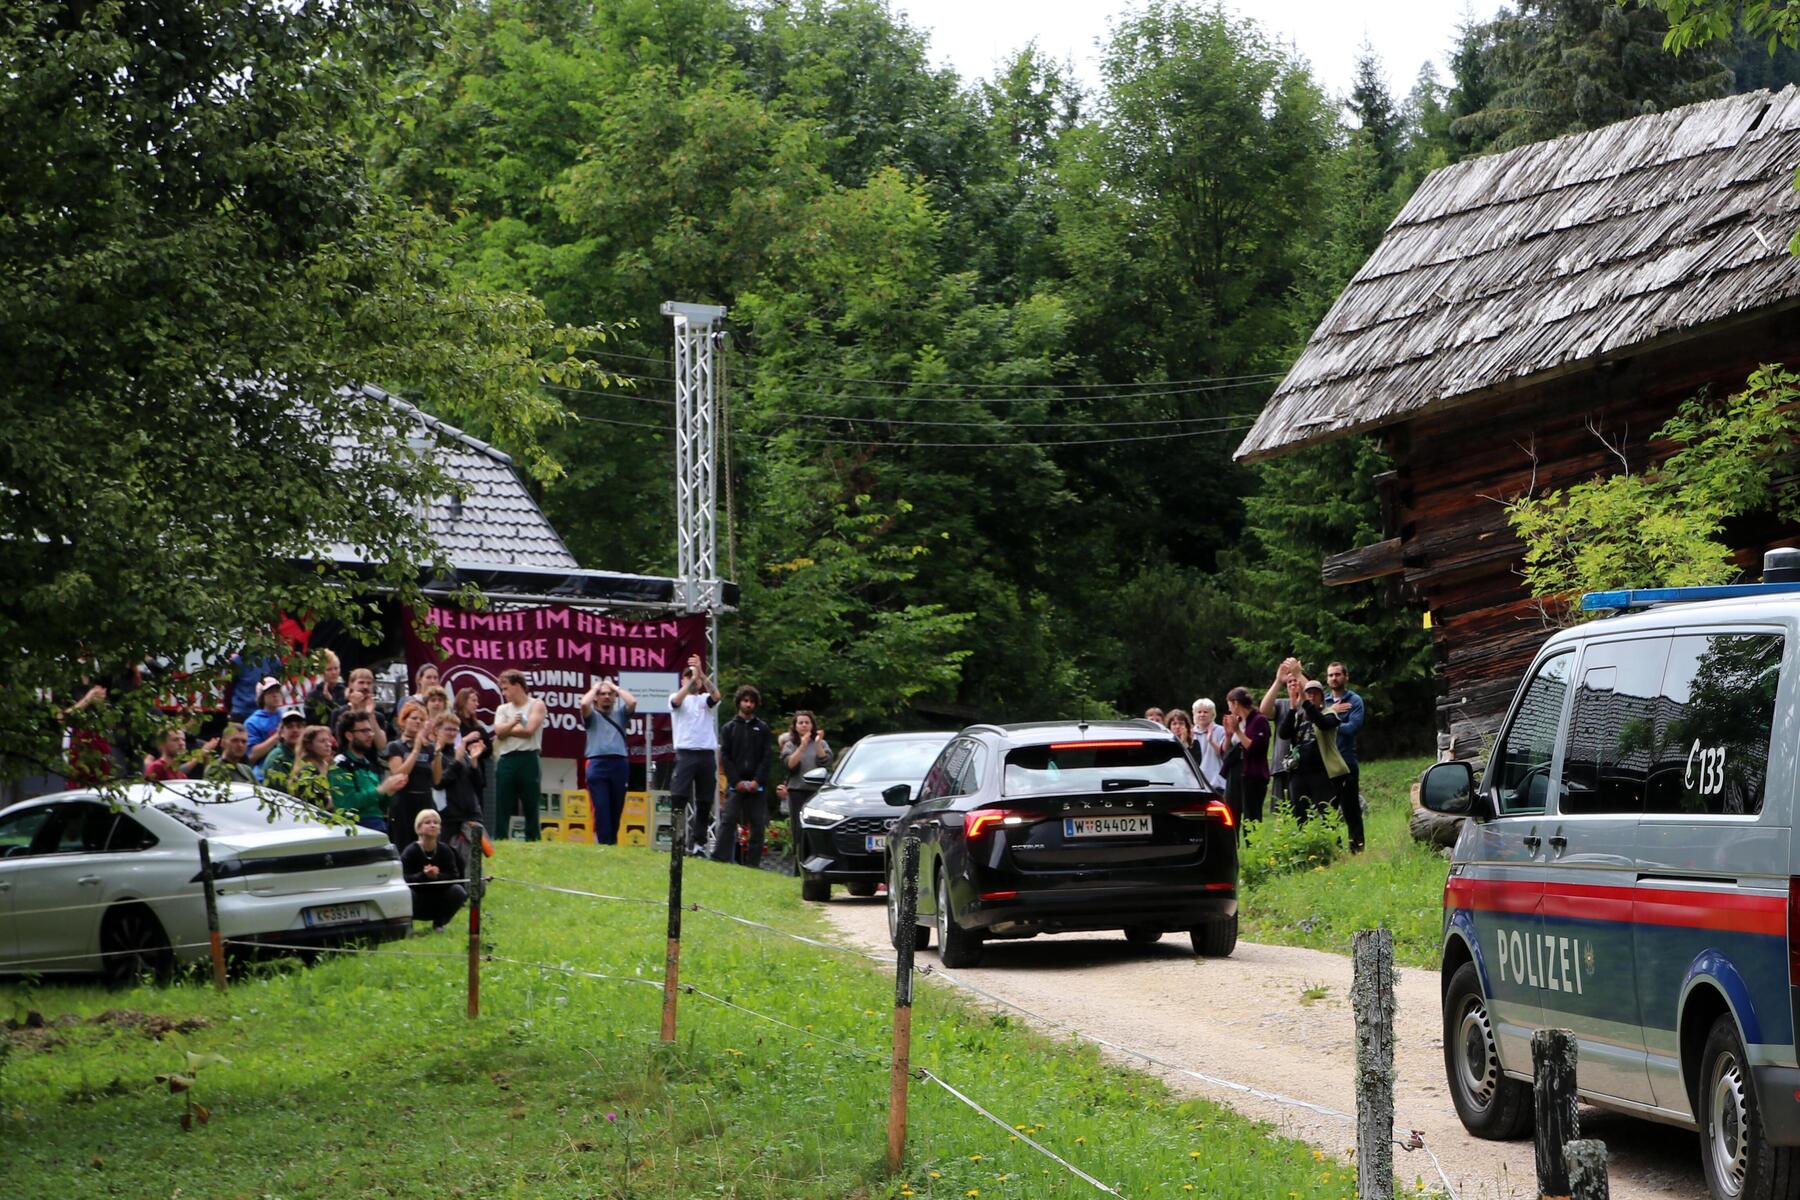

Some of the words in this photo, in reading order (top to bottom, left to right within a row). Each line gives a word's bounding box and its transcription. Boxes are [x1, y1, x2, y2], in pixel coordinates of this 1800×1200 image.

[426, 607, 528, 631] HEIMAT
[536, 608, 570, 629] IM
[557, 638, 592, 662] IM
[600, 644, 665, 668] HIRN
[522, 670, 585, 688] EUMNI
[1698, 746, 1726, 795] 133
[1497, 929, 1583, 995] POLIZEI
